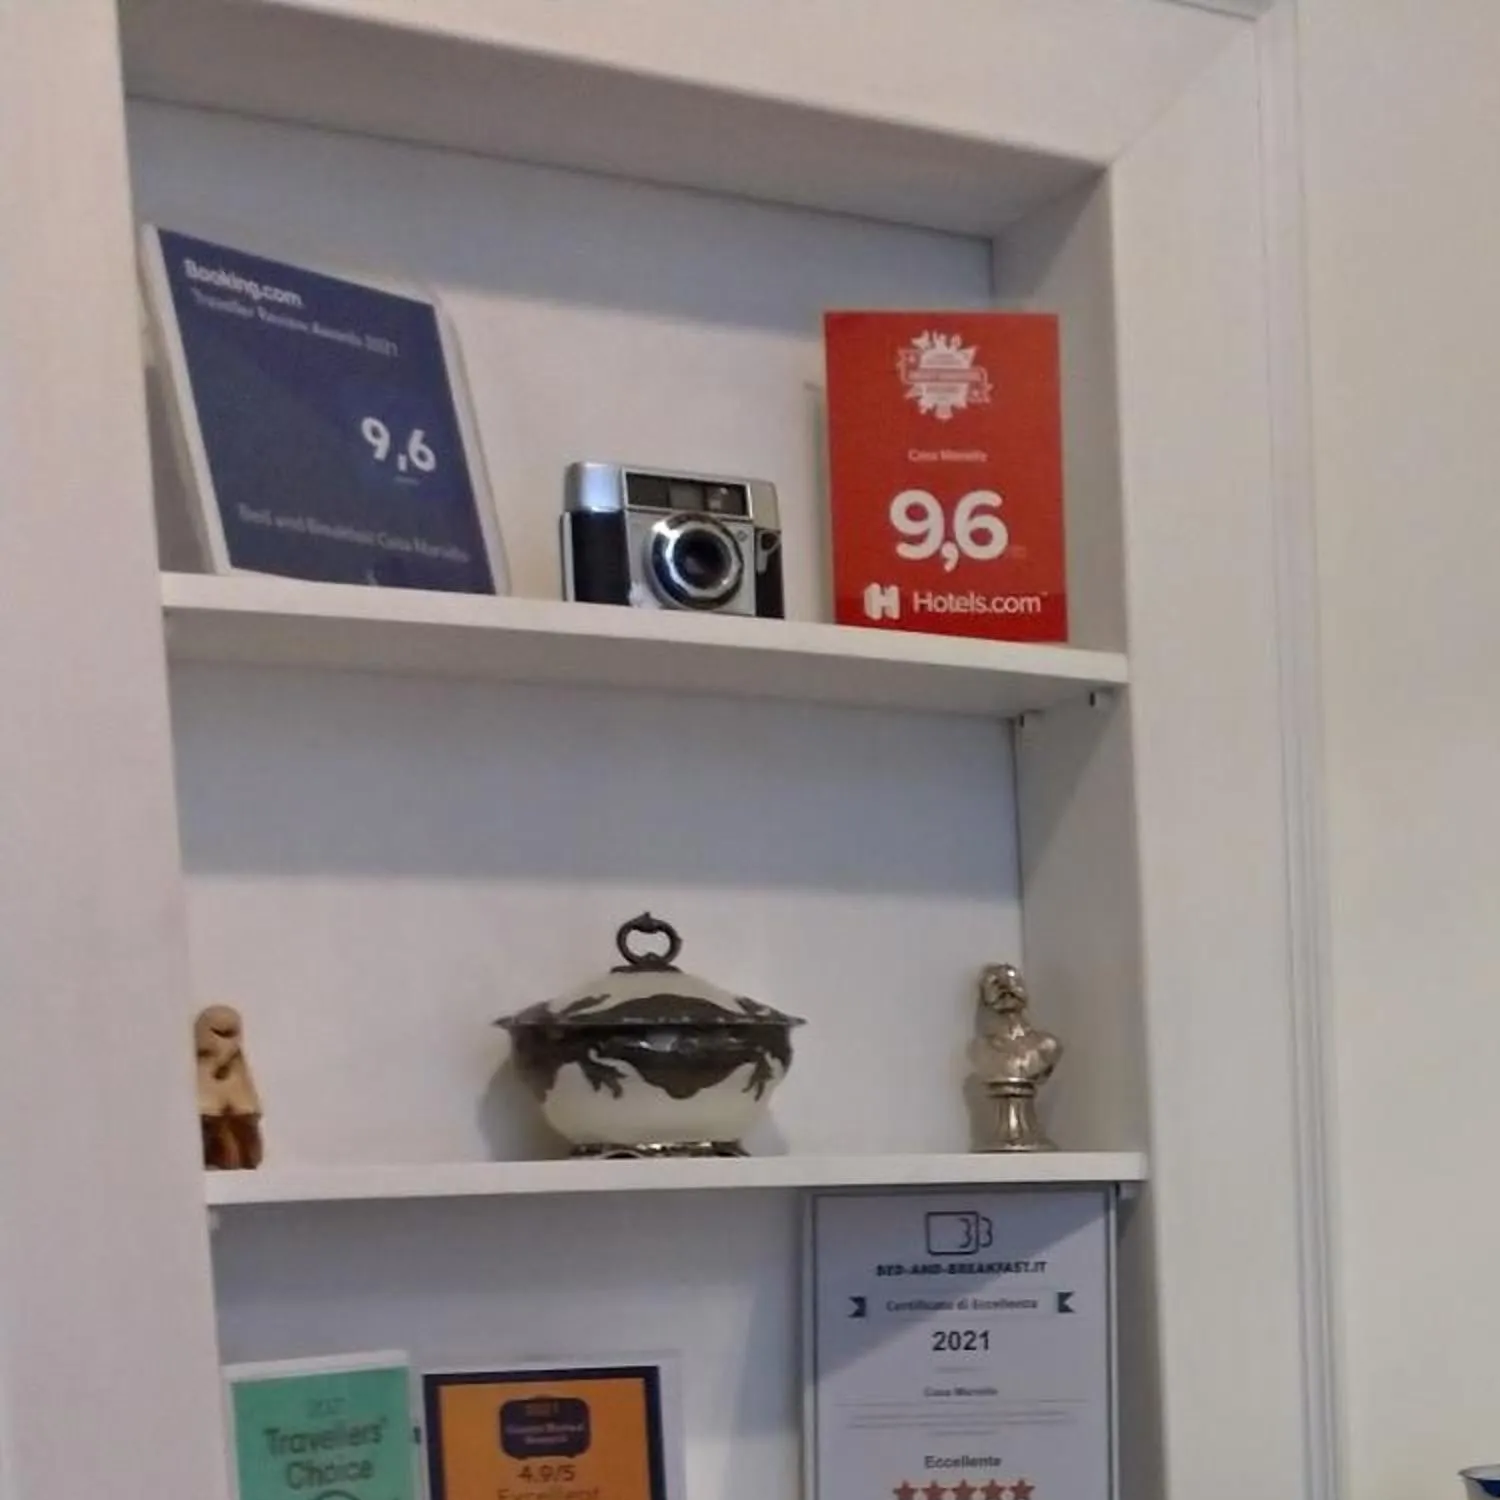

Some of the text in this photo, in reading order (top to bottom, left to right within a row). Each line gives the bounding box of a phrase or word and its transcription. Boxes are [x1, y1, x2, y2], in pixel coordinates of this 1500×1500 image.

[184, 257, 305, 308] Booking.com
[361, 416, 437, 473] 9,6
[889, 489, 1009, 572] 9,6
[912, 591, 1042, 614] Hotels.com
[876, 1261, 1048, 1277] BED-AND-BREAKFAST.IT
[932, 1329, 991, 1351] 2021
[285, 1459, 375, 1490] Choice
[924, 1455, 1002, 1469] Eccellente
